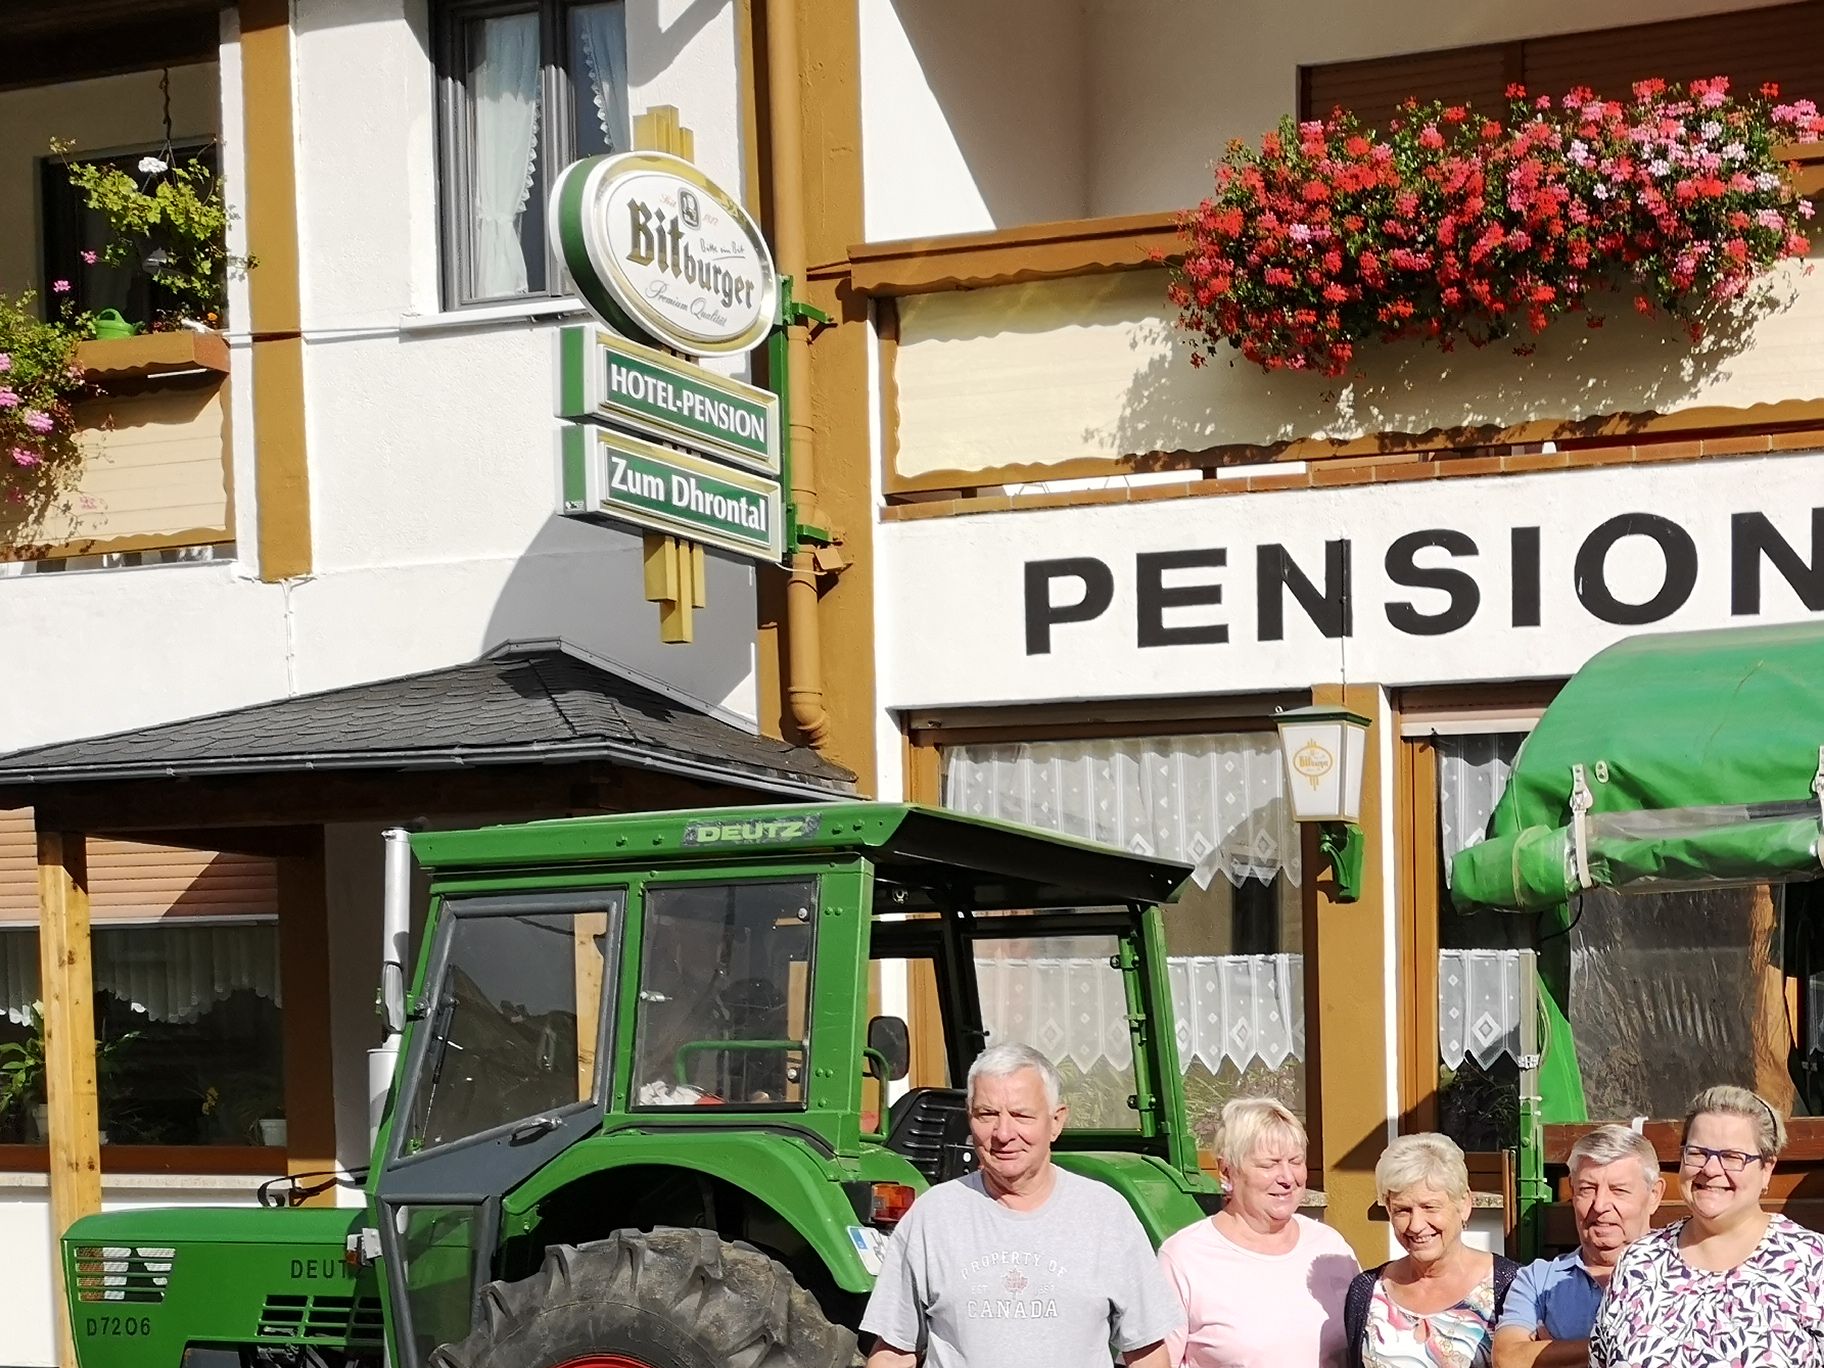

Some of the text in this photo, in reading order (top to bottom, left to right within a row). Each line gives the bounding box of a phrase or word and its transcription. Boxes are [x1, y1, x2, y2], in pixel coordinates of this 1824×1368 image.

[626, 198, 755, 309] Bitburger
[645, 279, 728, 327] Premium Qualität
[611, 363, 765, 443] HOTEL-PENSION
[611, 456, 768, 532] Zum Dhrontal
[696, 821, 804, 843] DEUTZ
[291, 1259, 349, 1279] DEUT
[961, 1250, 1068, 1280] PROPERTY OF
[967, 1299, 1059, 1319] CANADA
